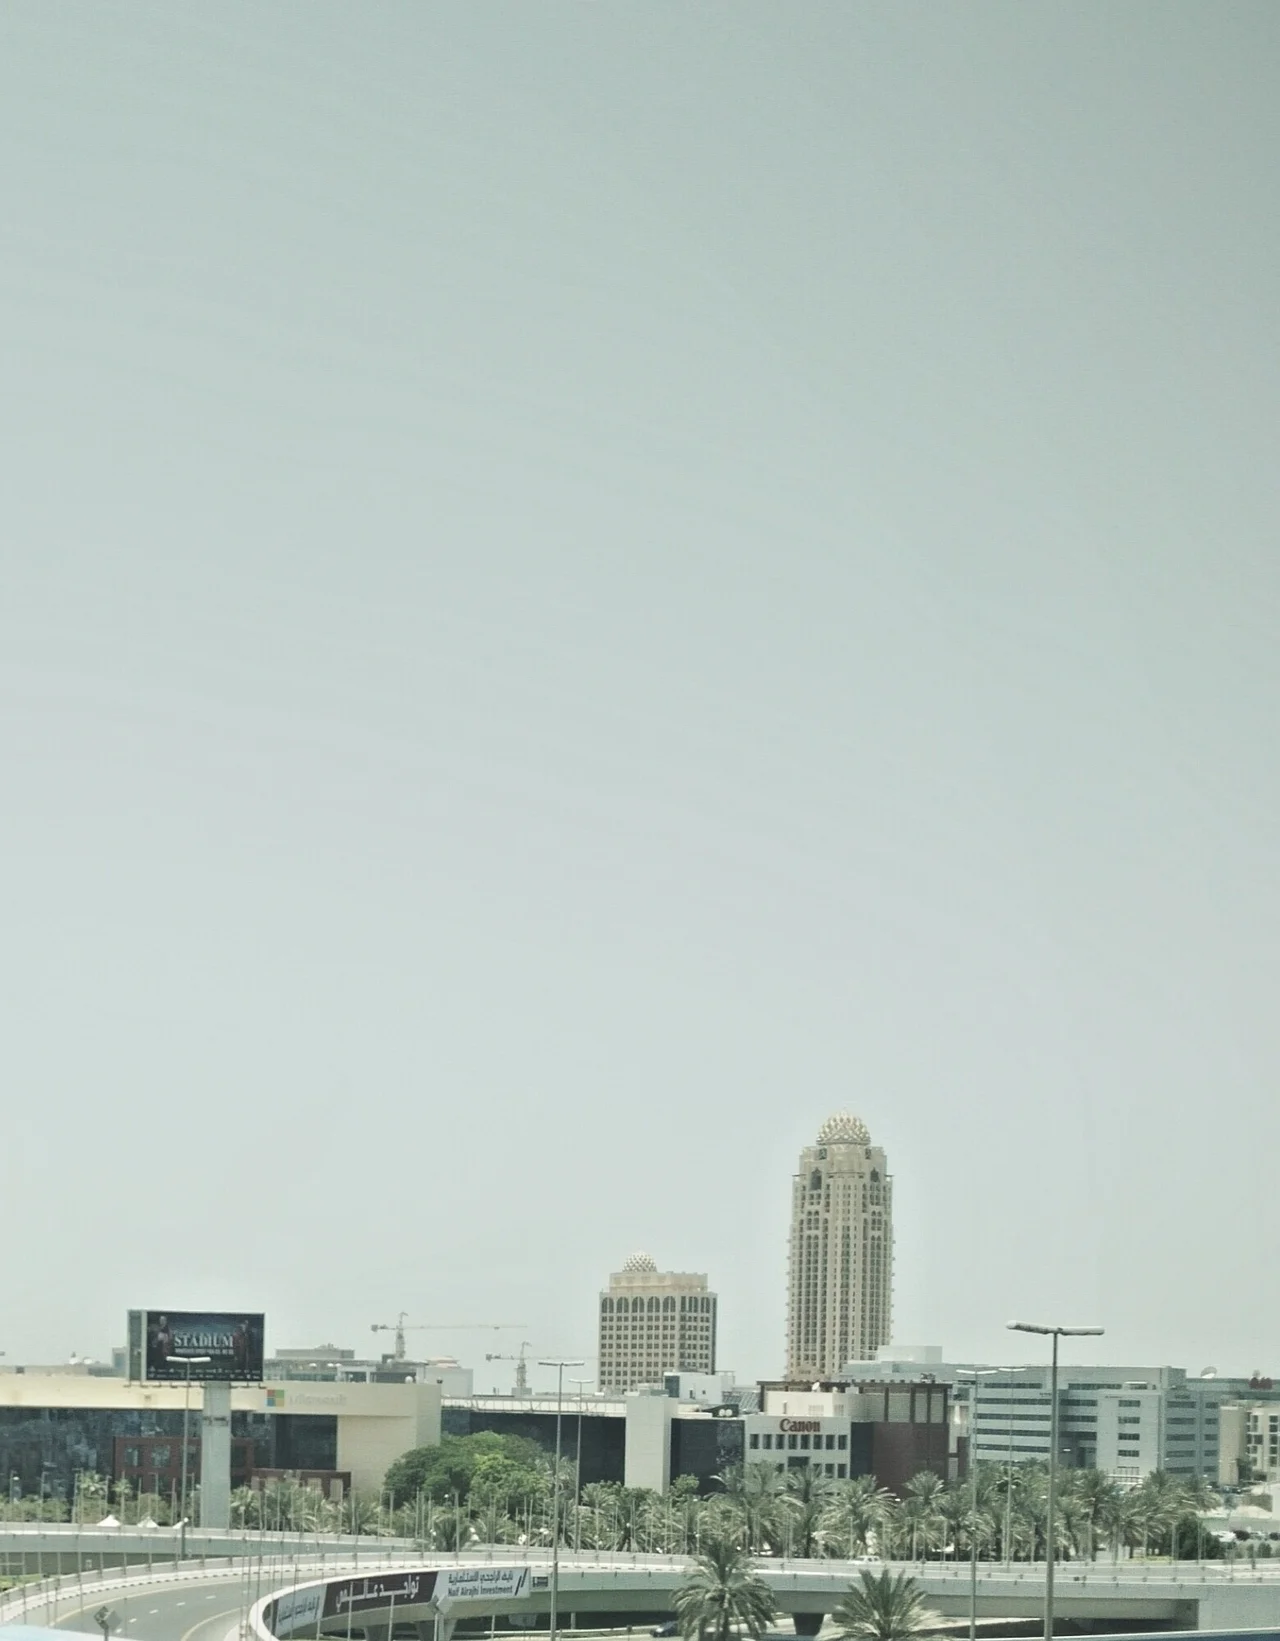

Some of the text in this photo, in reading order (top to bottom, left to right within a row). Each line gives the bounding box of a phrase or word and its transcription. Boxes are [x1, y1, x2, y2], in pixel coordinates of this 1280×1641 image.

[174, 1335, 234, 1347] STADIUM
[779, 1418, 821, 1432] Canon
[480, 1585, 513, 1595] Investment
